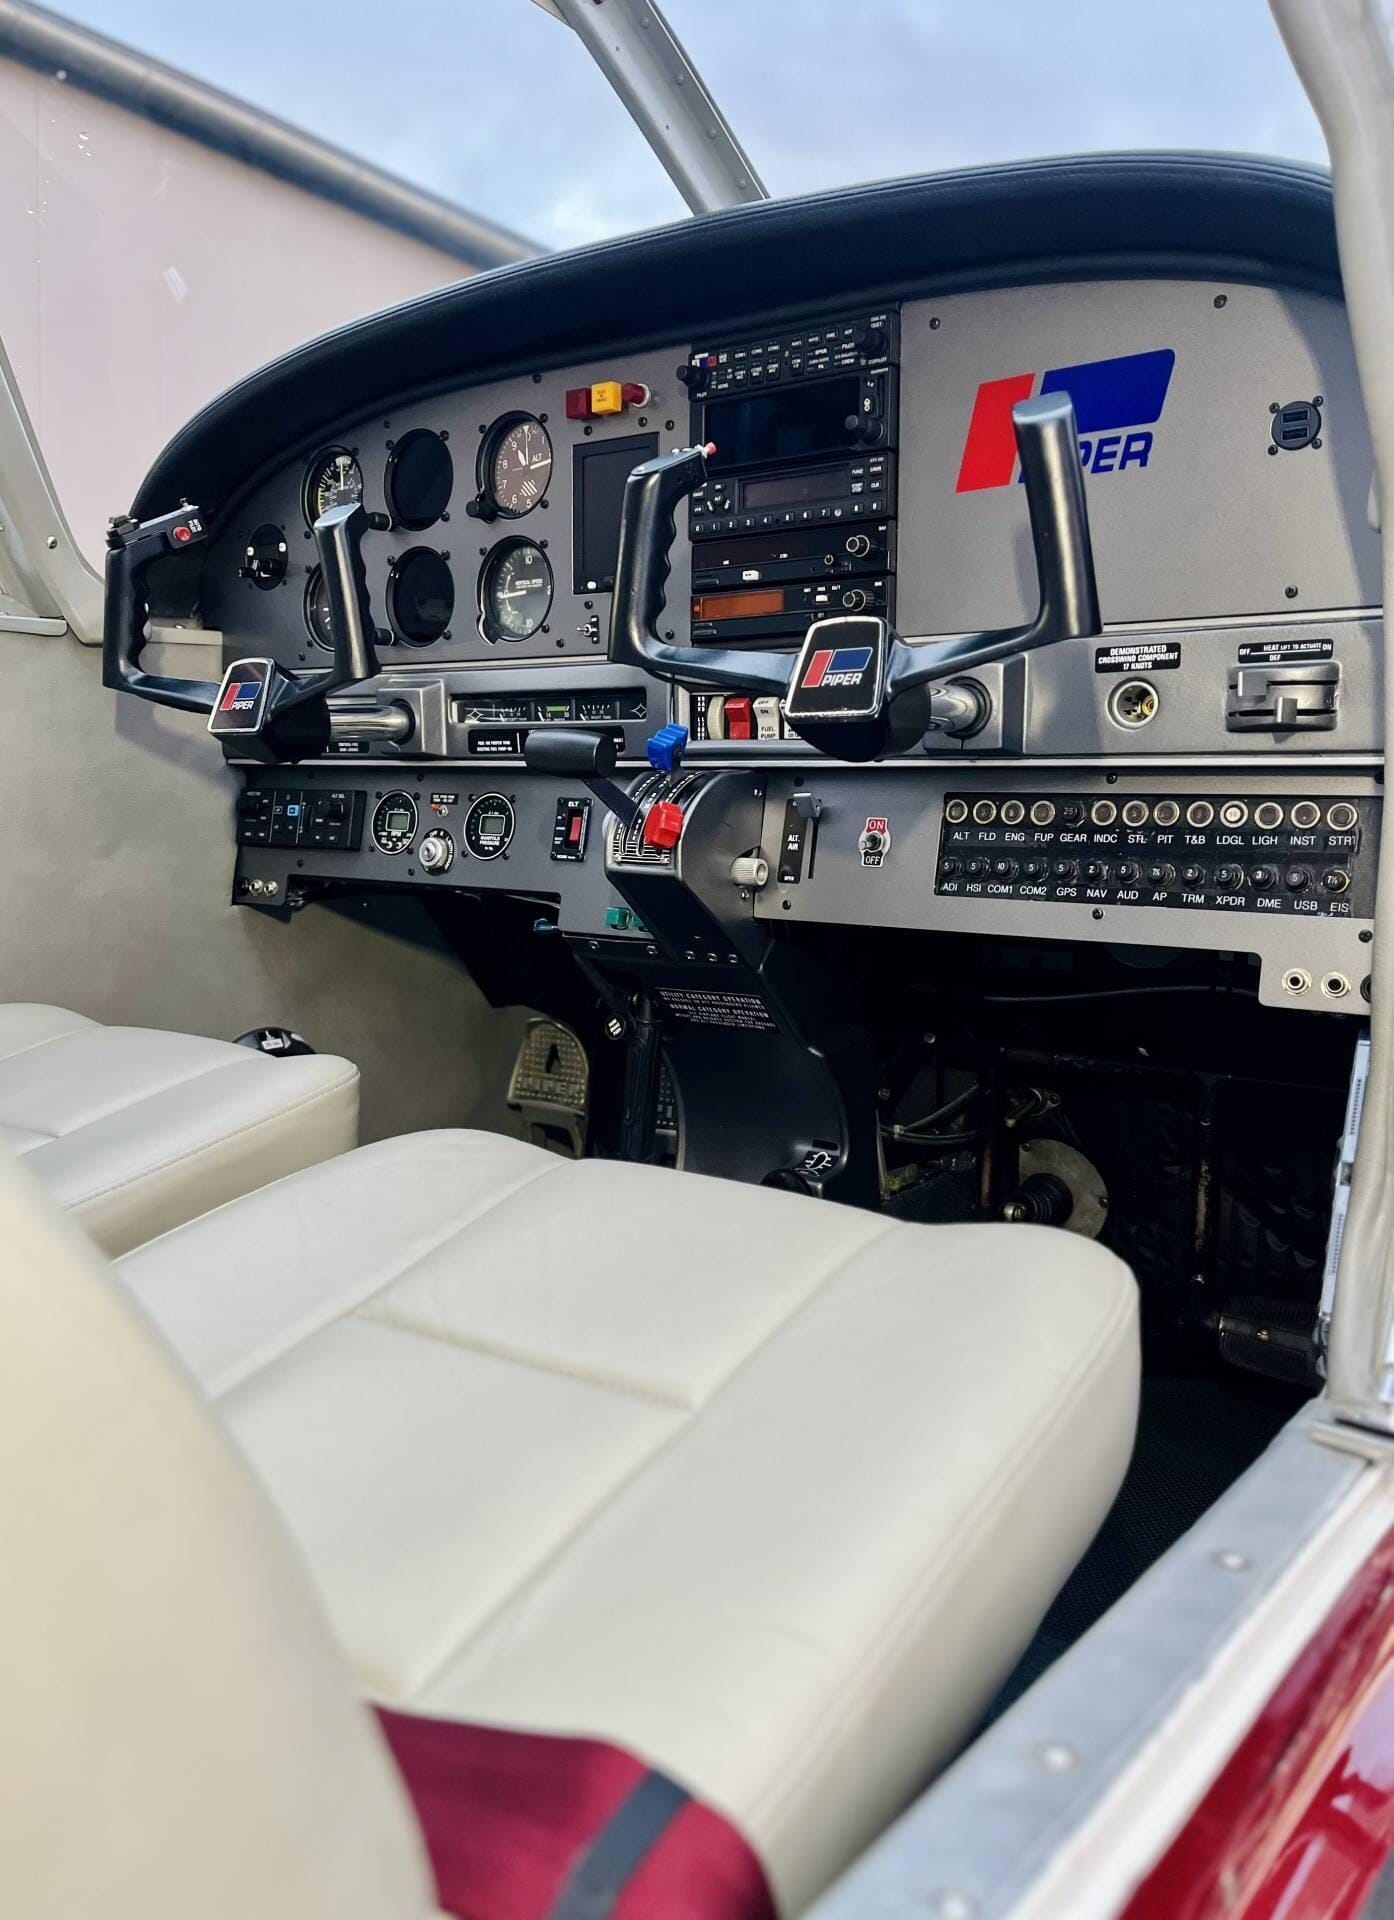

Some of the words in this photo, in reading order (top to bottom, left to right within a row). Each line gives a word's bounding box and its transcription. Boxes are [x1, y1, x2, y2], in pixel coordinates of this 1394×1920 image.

[512, 441, 517, 450] 9
[532, 453, 542, 462] ALT
[502, 460, 508, 469] 8
[502, 480, 507, 488] 7
[512, 494, 517, 504] 6
[526, 500, 532, 508] 5
[525, 555, 532, 565] 10
[1110, 645, 1167, 656] DEMONSTRATED
[1098, 655, 1136, 664] CROSSWIND
[1138, 652, 1178, 662] COMPONENT
[1130, 662, 1152, 670] KNOTS
[821, 672, 862, 687] PIPER
[231, 701, 254, 710] PIPER
[869, 820, 884, 830] ON
[953, 832, 970, 840] ALT
[979, 832, 996, 841] FLD
[1005, 833, 1025, 841] ENG
[1034, 833, 1054, 842] FUP
[1060, 834, 1087, 842] GEAR
[1093, 834, 1118, 843] INDC
[1128, 834, 1147, 844] STL
[1157, 834, 1174, 844] PIT
[1184, 835, 1206, 844] T&B
[1216, 835, 1244, 845] LDGL
[1252, 836, 1278, 845] LIGH
[1290, 836, 1317, 846] INST
[865, 856, 881, 864] OFF
[998, 862, 1005, 870] 10
[1058, 864, 1064, 872] 5
[1088, 866, 1095, 874] 2
[1121, 866, 1127, 874] 5
[1187, 869, 1193, 877] 2
[1221, 870, 1227, 878] 5
[1256, 870, 1262, 879] 3
[1292, 873, 1298, 881] 5
[943, 883, 958, 891] ADI
[966, 883, 982, 892] HSI
[987, 885, 1013, 894] COM1
[1020, 886, 1047, 895] COM2
[1056, 888, 1077, 897] GPS
[1086, 889, 1108, 898] NAV
[1117, 890, 1139, 900] AUD
[1152, 892, 1168, 901] AP
[1182, 894, 1205, 904] TRM
[1215, 895, 1246, 906] XPDR
[1256, 898, 1282, 908] DME
[1294, 900, 1318, 911] USB
[1330, 902, 1349, 912] EIS
[722, 996, 761, 1004] OPERATION
